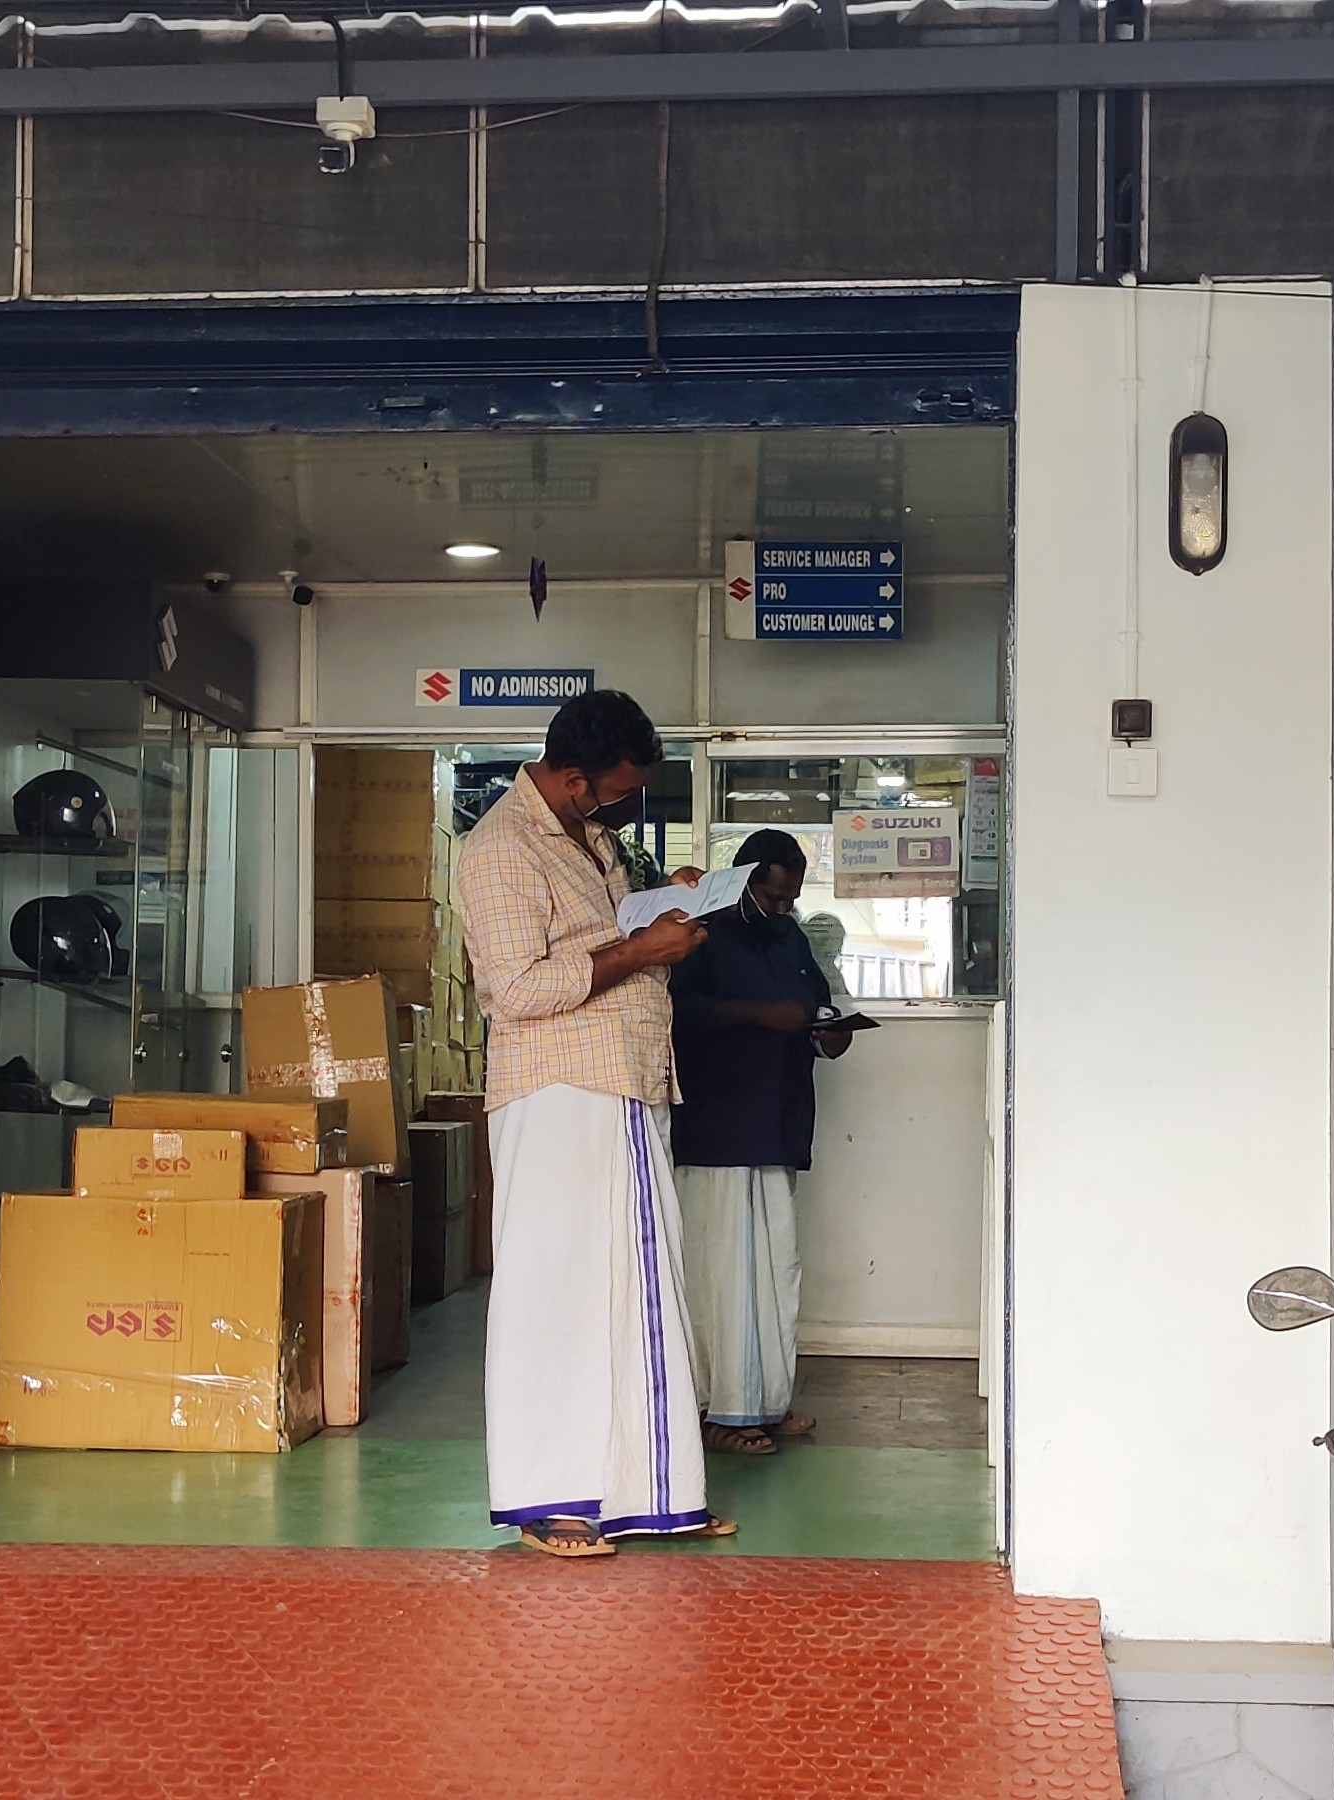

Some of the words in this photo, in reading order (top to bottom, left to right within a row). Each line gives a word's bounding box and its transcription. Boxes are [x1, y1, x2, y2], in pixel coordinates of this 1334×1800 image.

[763, 550, 812, 567] SERVICE
[815, 550, 871, 567] MANAGER
[763, 583, 787, 600] PRO
[762, 613, 826, 632] CUSTOMER
[828, 613, 875, 632] LOUNGE
[471, 676, 494, 697] NO
[498, 676, 587, 697] ADMISSION
[871, 817, 941, 829] SUZUKI
[841, 854, 877, 866] System
